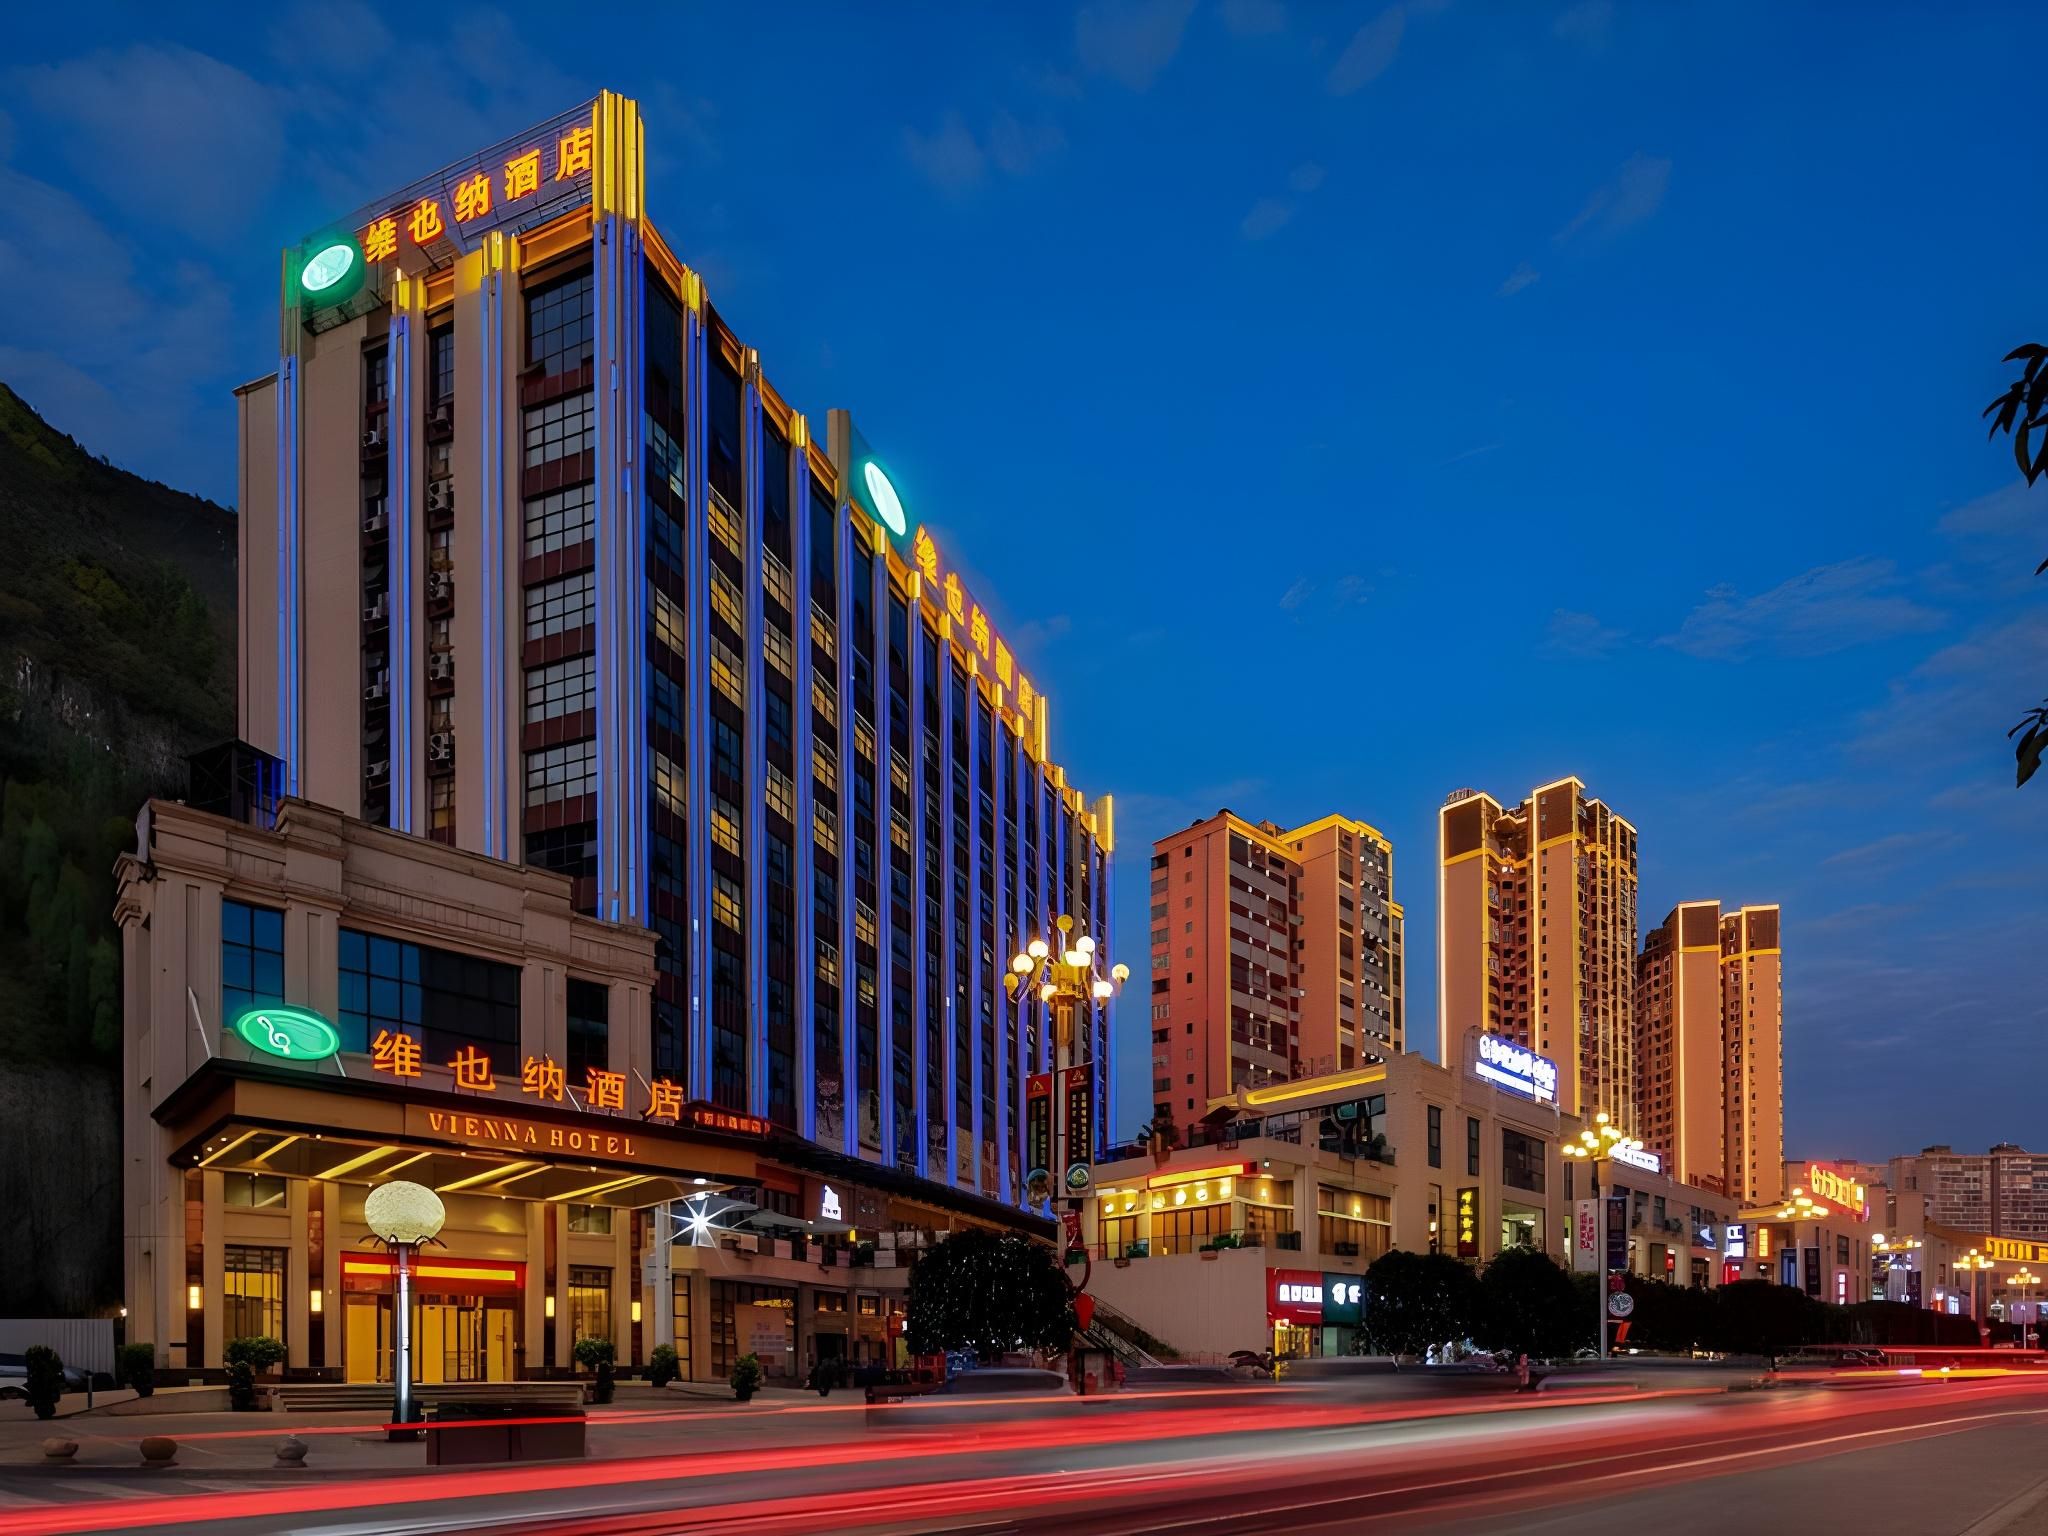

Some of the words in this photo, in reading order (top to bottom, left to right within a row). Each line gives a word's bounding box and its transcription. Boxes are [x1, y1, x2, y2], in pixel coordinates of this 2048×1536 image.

[366, 127, 592, 263] 维也纳酒店
[372, 1029, 683, 1121] 维也纳酒店
[428, 1112, 537, 1145] VIENNA
[551, 1129, 635, 1156] HOTEL
